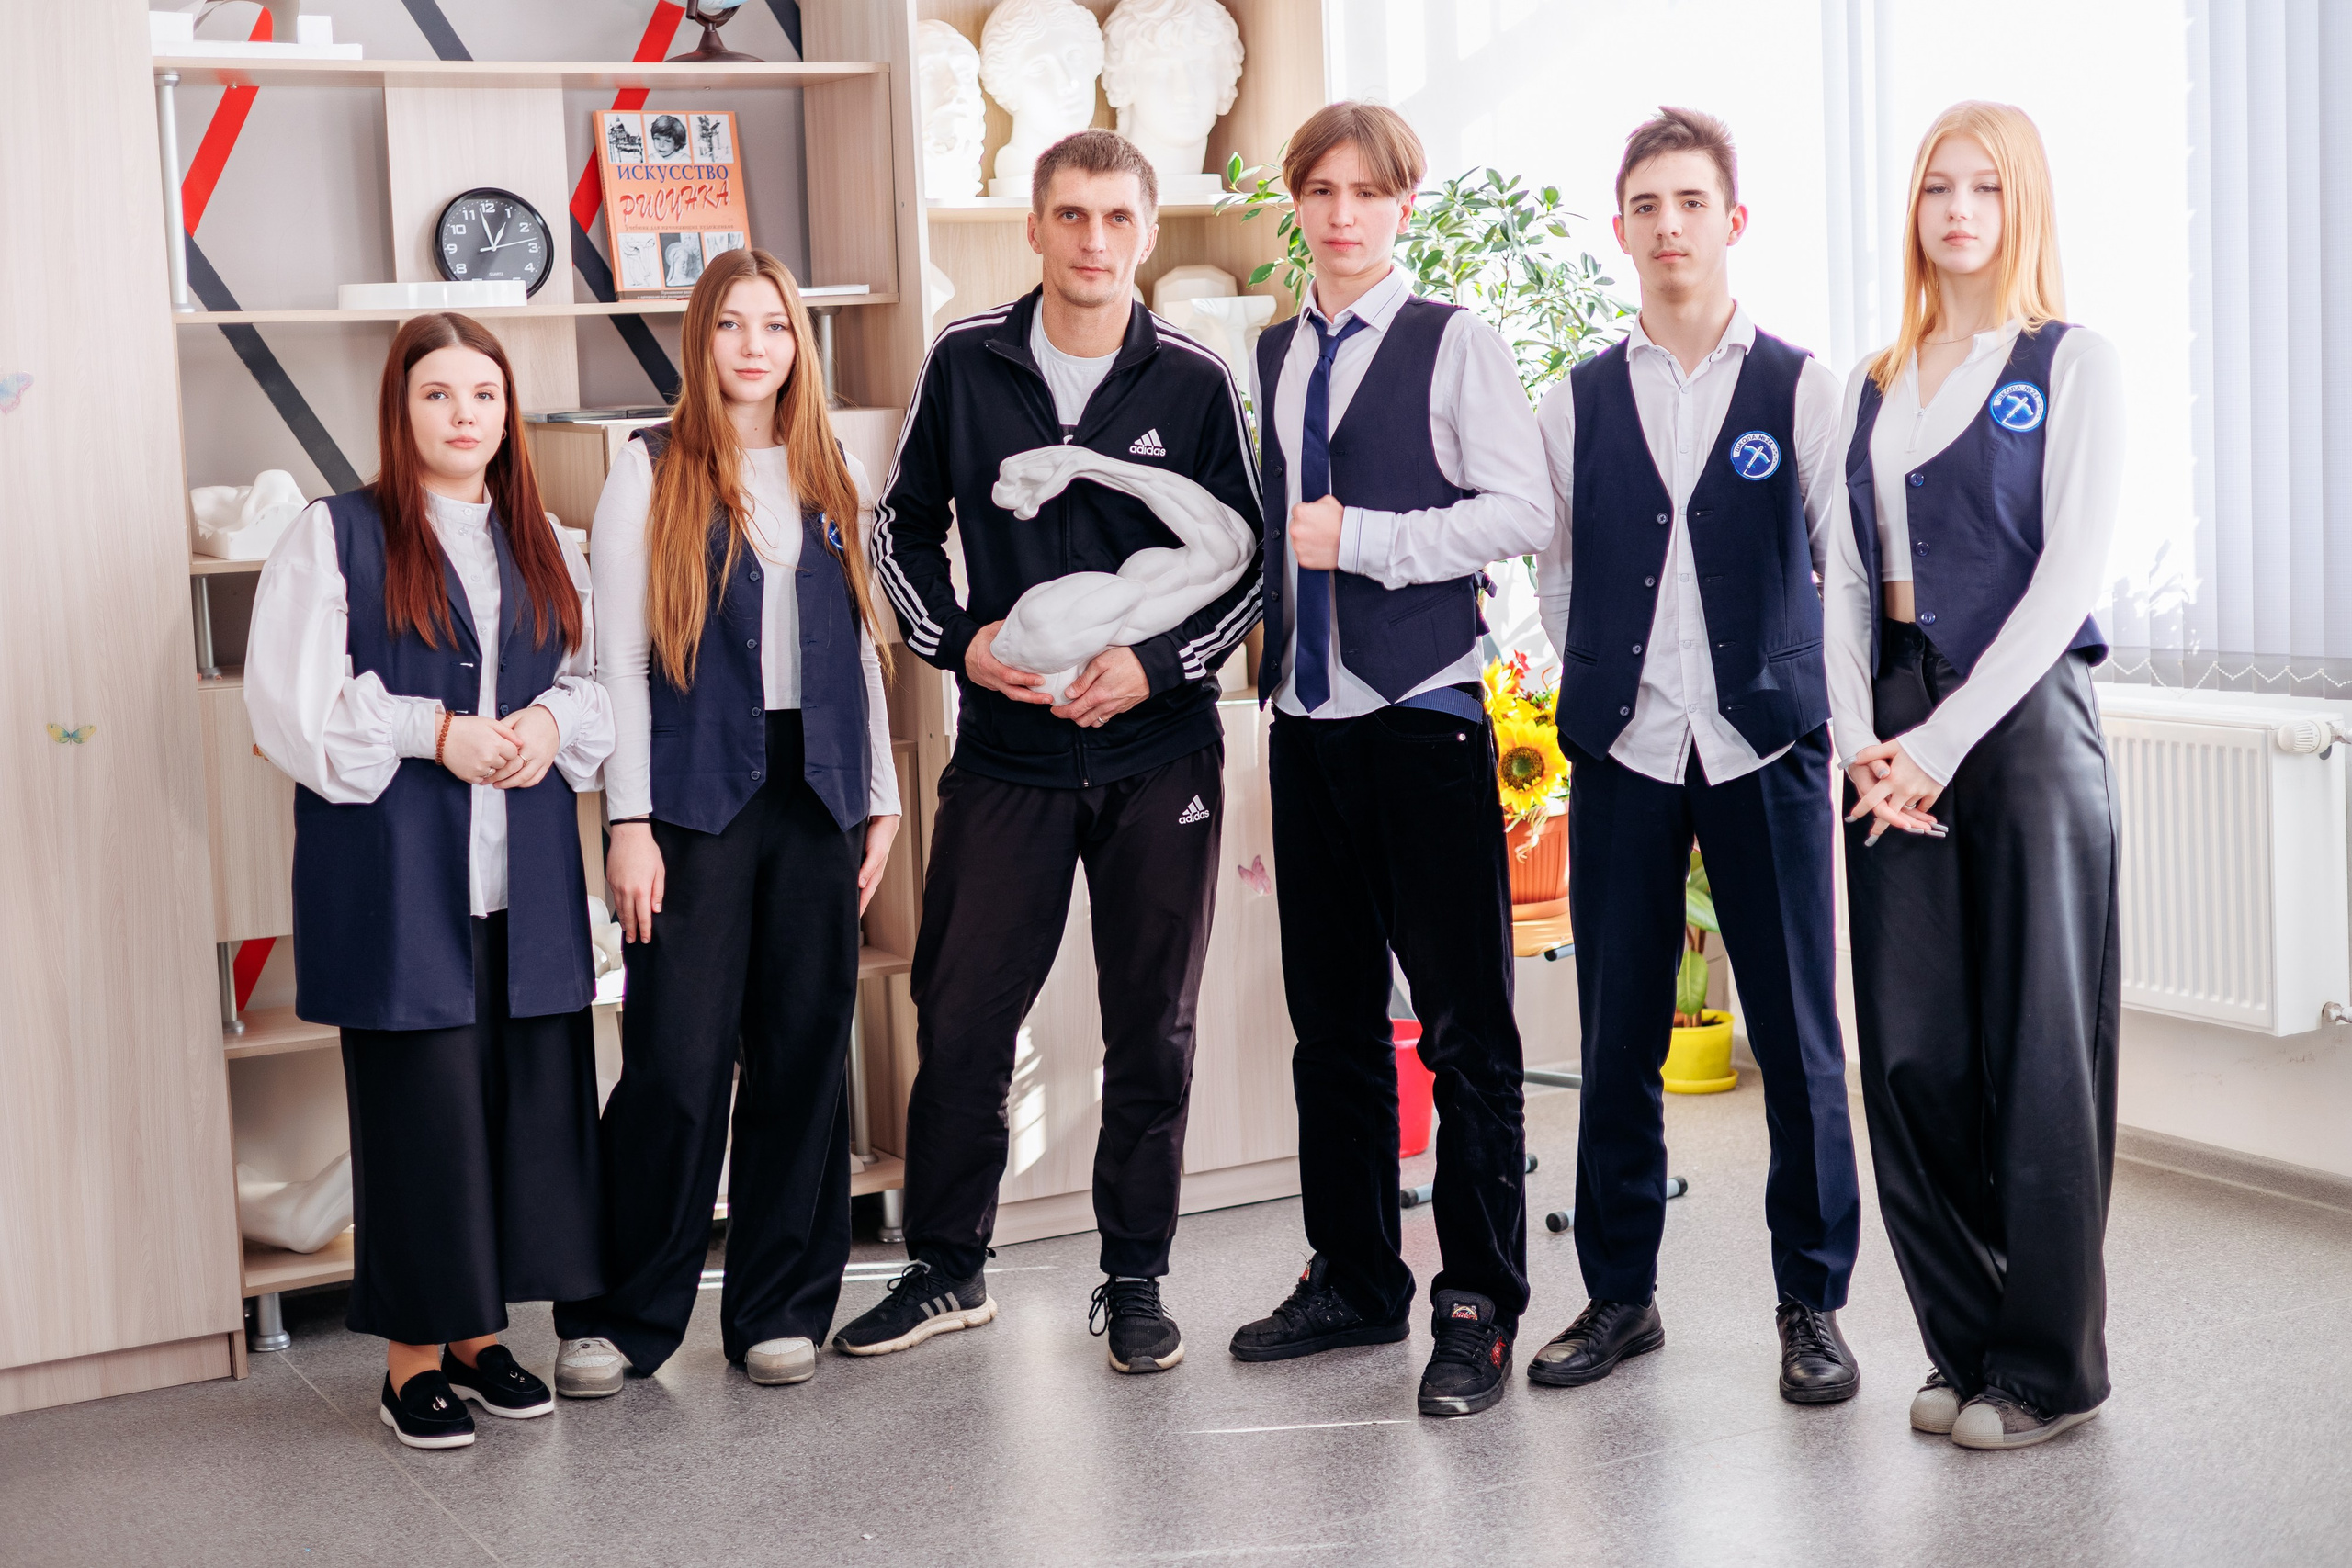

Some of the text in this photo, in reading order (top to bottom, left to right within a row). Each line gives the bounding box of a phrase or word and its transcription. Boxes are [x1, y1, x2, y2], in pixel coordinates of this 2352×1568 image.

[617, 164, 729, 183] ИСКУССТВО
[620, 179, 731, 223] РИСУНКА
[480, 202, 496, 213] 12
[462, 209, 476, 220] 11
[504, 208, 512, 219] 1
[450, 224, 467, 235] 10
[519, 222, 530, 233] 2
[447, 243, 458, 254] 9
[528, 243, 539, 253] 3
[456, 263, 467, 274] 8
[524, 262, 536, 273] 4
[1996, 385, 2022, 401] ШКОЛА
[1735, 434, 1757, 453] ШКОЛА
[1129, 445, 1166, 457] adidas
[1178, 809, 1210, 825] adidas
